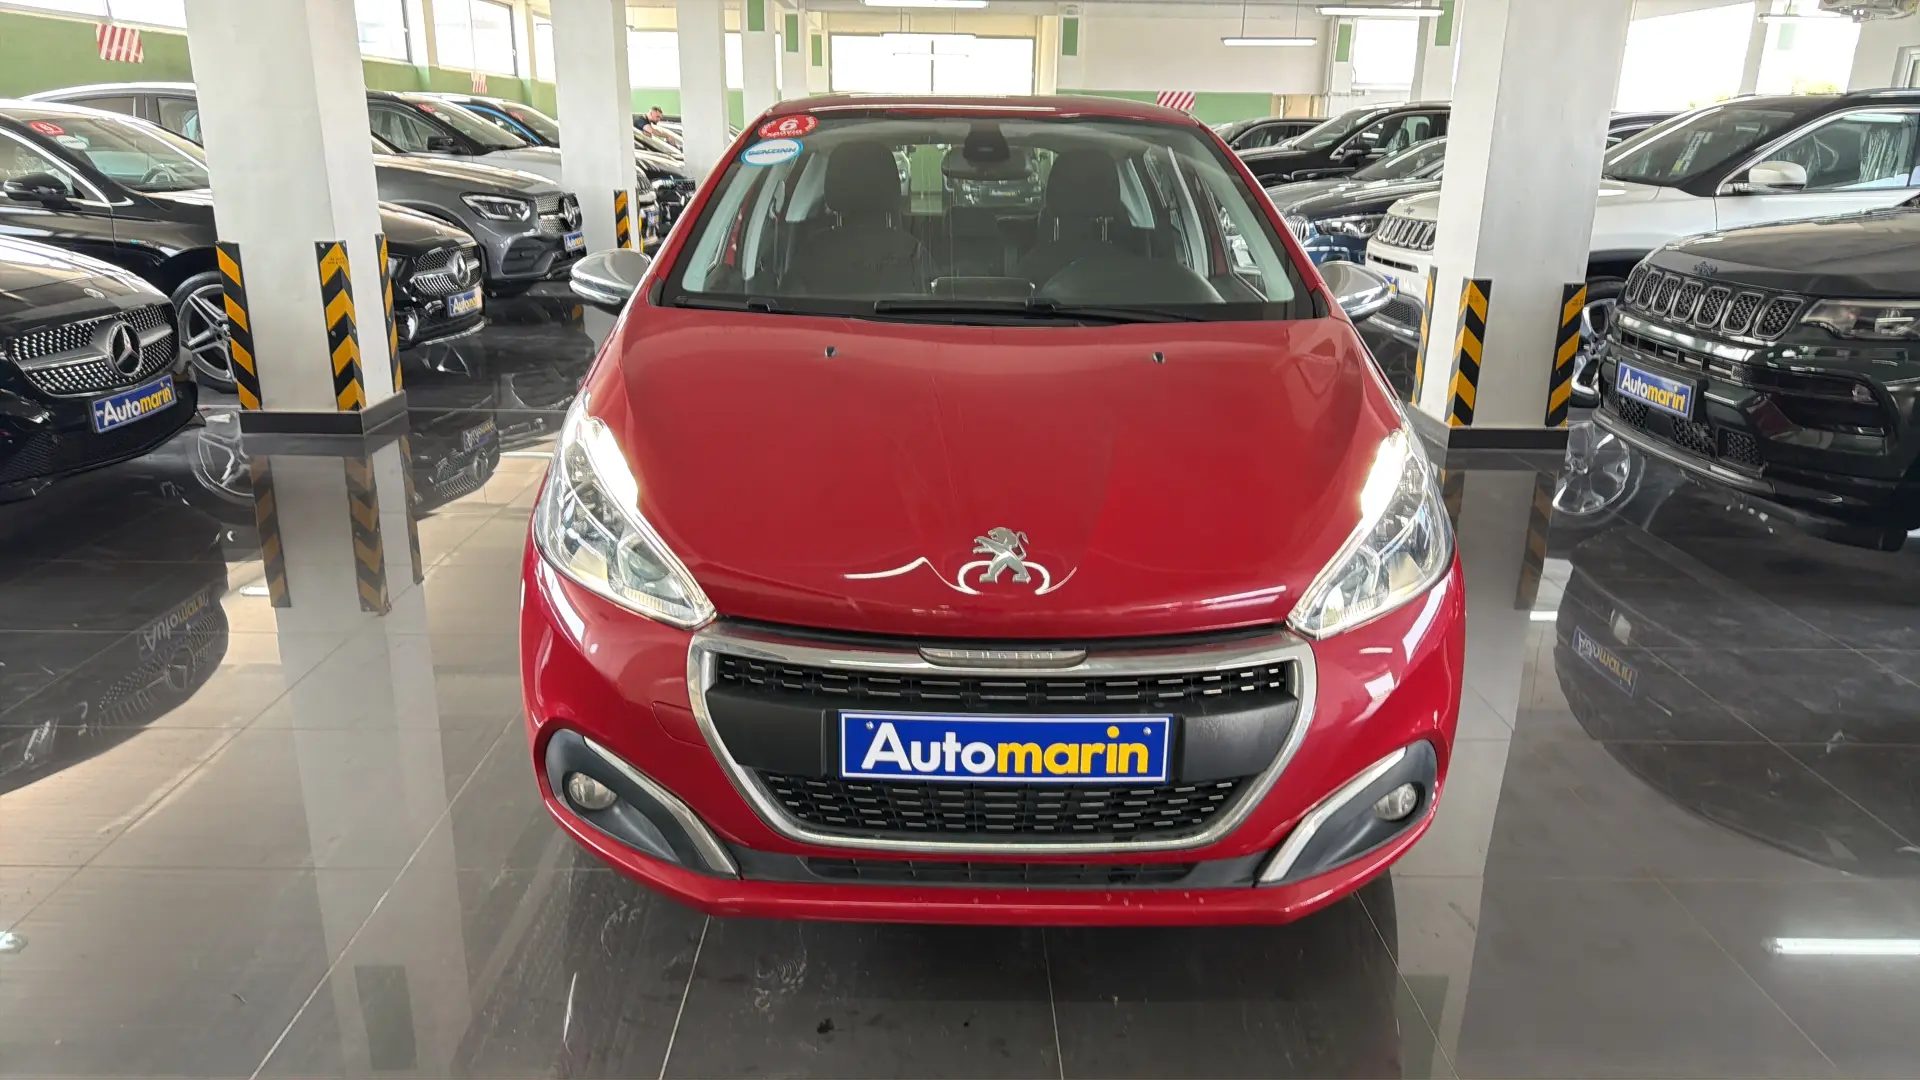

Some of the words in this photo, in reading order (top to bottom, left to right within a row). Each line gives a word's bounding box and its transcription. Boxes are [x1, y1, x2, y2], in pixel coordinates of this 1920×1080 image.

[779, 118, 799, 131] 6
[103, 381, 173, 426] Automarin
[1621, 368, 1686, 412] Automarin
[861, 722, 1149, 774] Automarin
